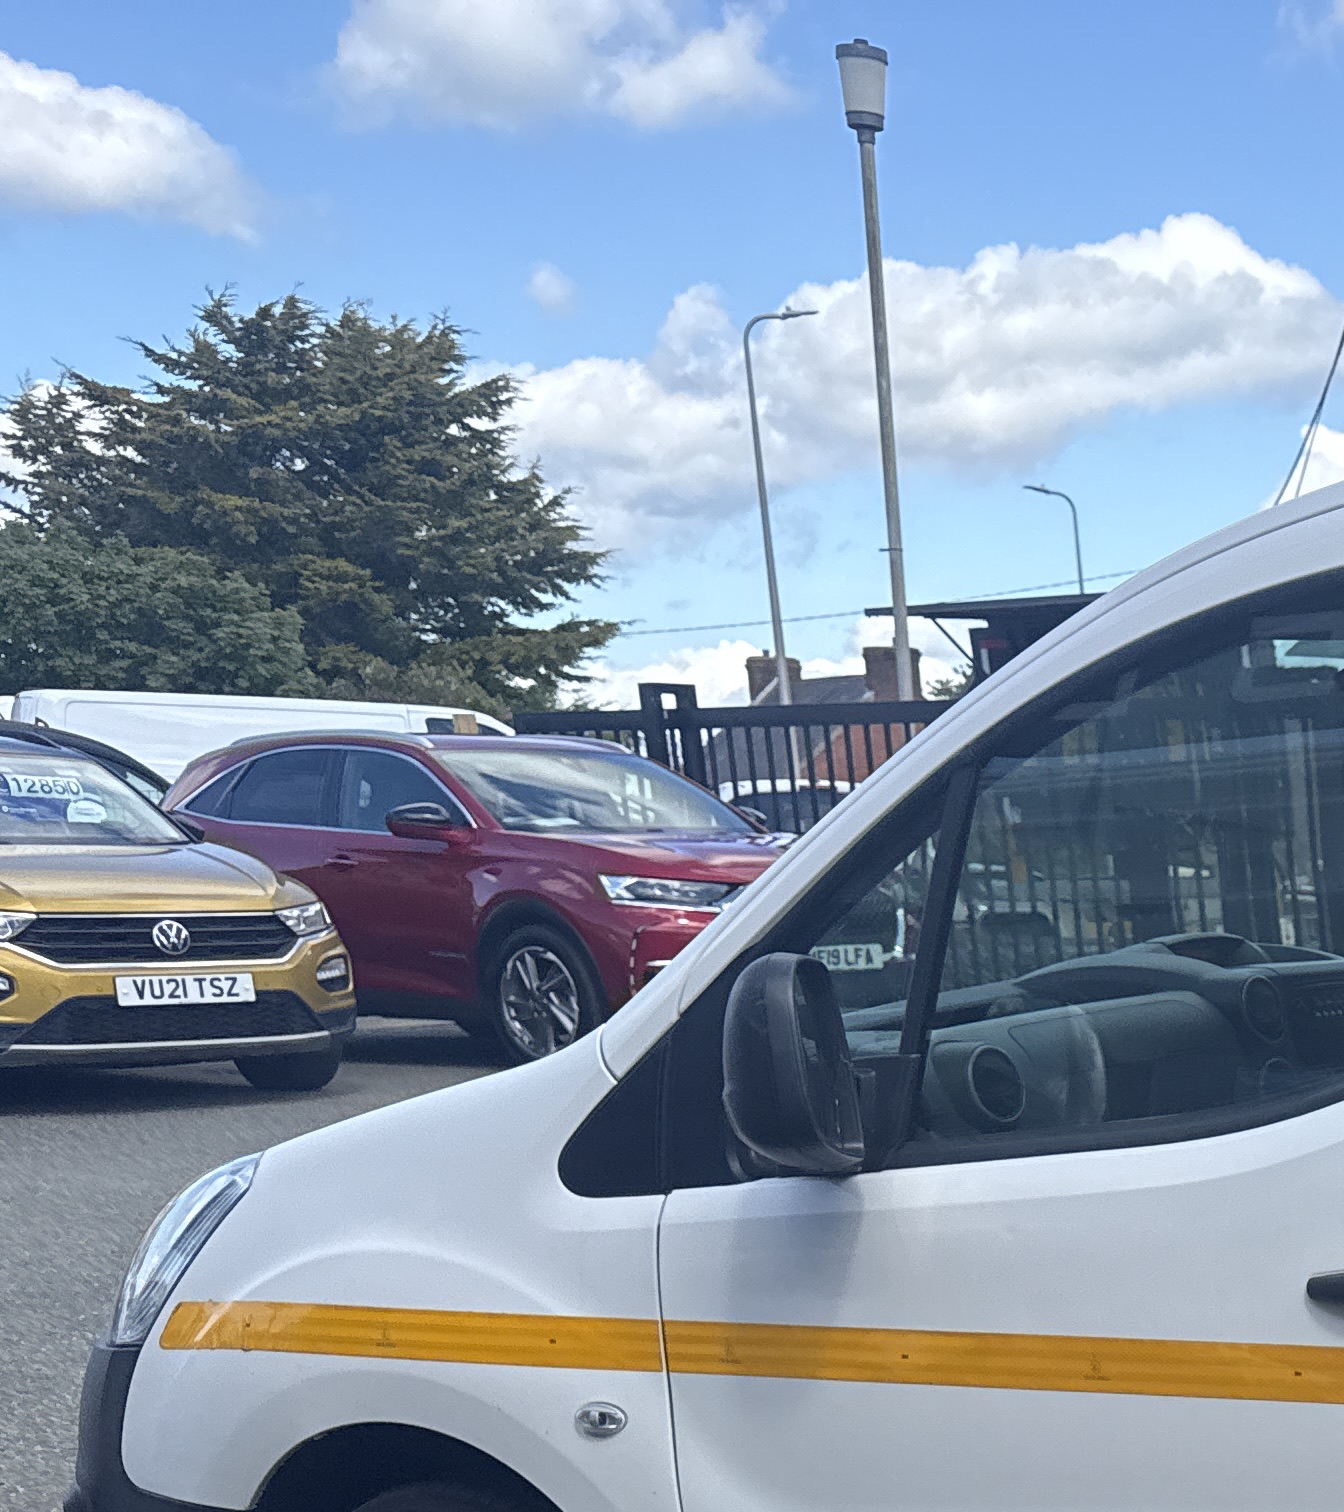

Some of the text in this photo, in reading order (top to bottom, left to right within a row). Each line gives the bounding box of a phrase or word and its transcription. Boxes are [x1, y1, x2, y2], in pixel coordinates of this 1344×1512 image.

[10, 776, 81, 796] 12850
[844, 948, 874, 966] LFA
[132, 976, 240, 1000] VU21 TSZ
